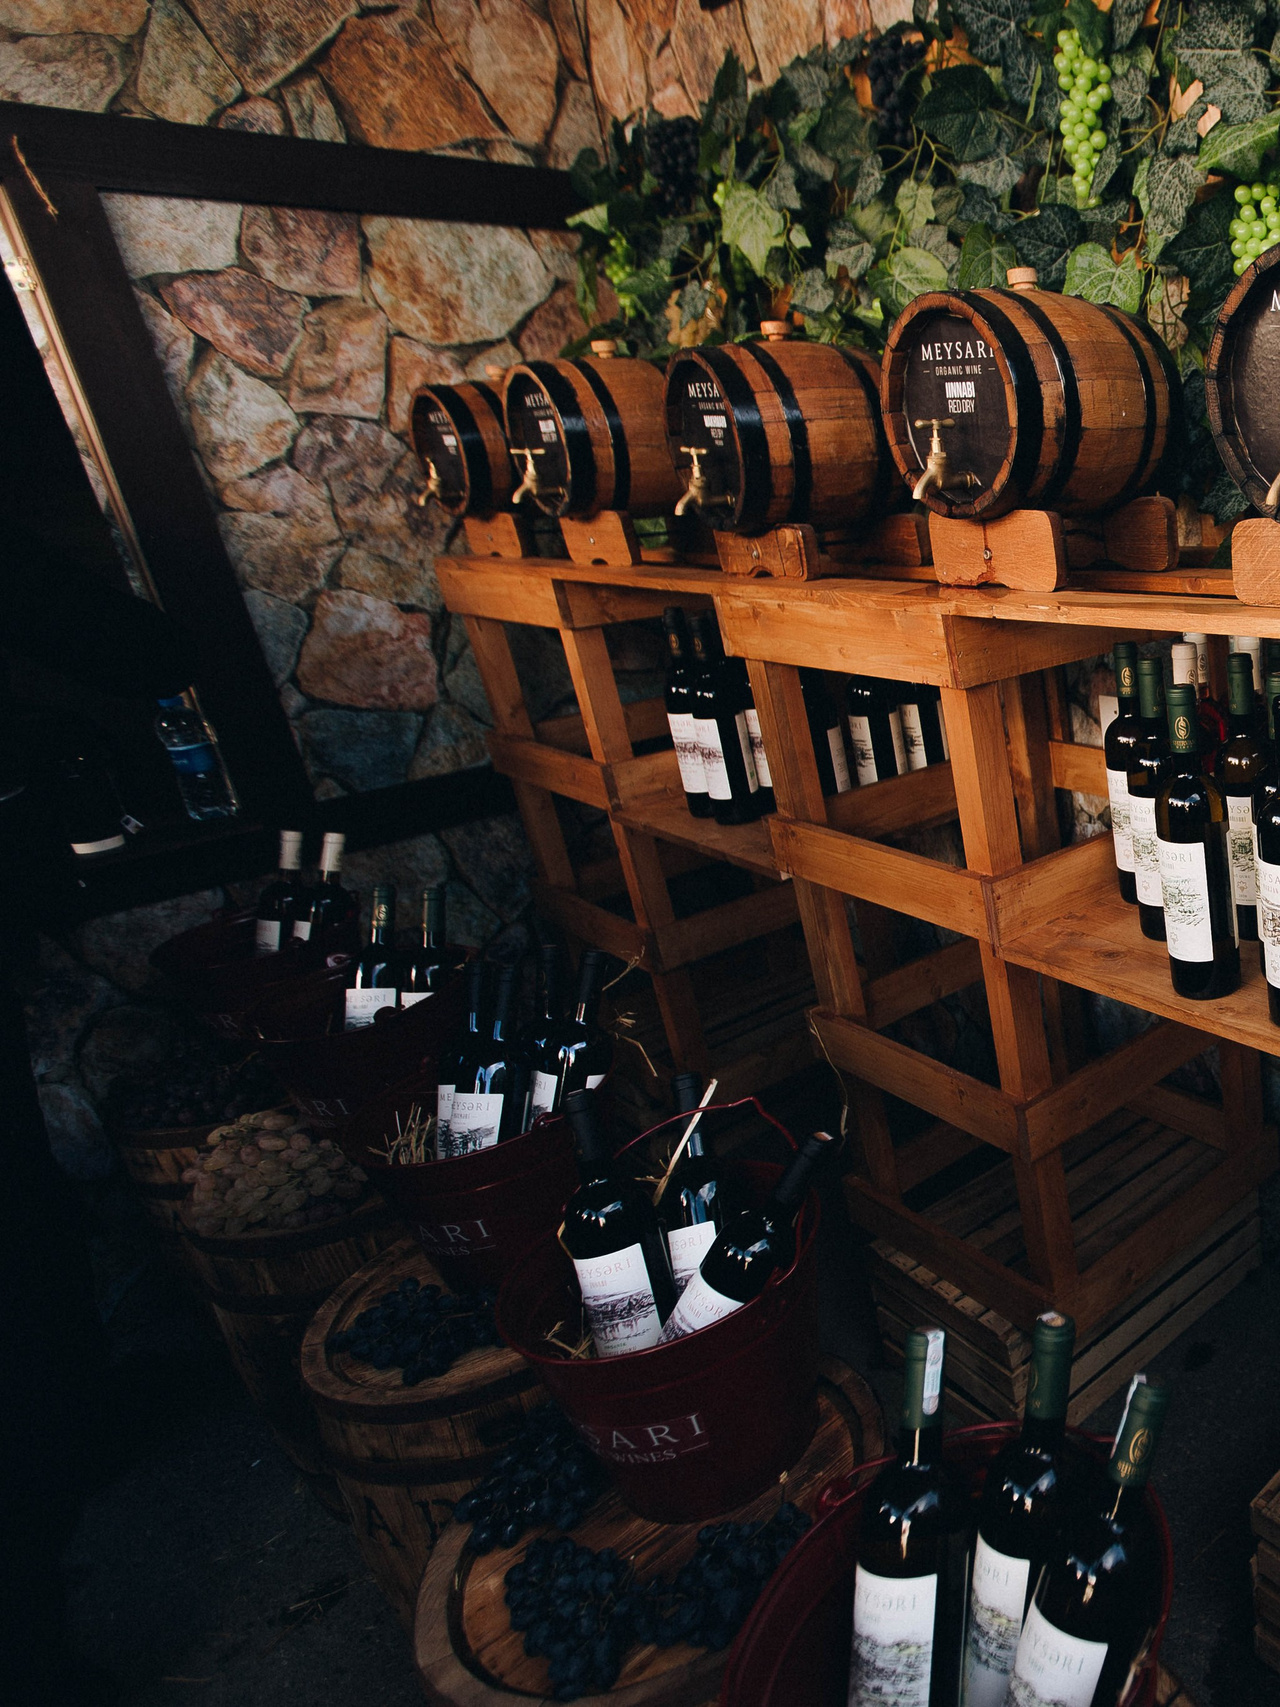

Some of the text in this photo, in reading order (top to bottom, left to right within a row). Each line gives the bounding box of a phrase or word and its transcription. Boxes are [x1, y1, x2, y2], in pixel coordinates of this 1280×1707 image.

[935, 364, 982, 376] ORGANIC WINE
[687, 382, 720, 398] MEYSA
[948, 399, 975, 414] RED DRY
